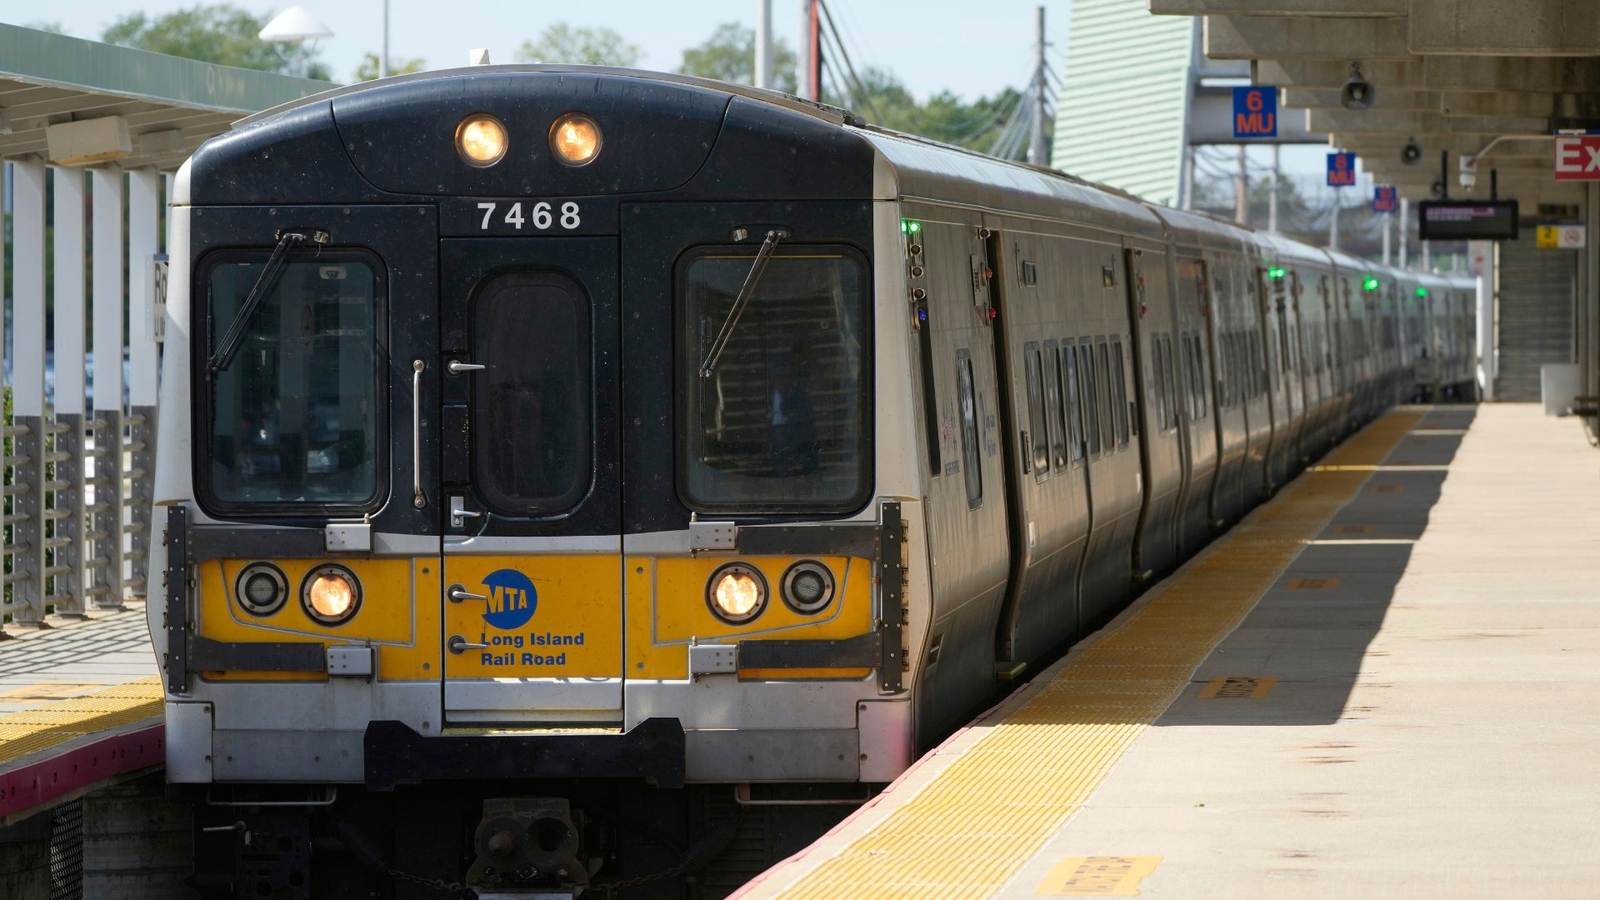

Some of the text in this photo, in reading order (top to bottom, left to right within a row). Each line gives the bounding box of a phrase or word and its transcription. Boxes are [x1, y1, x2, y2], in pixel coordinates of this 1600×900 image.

[1246, 90, 1263, 112] 6
[1236, 112, 1273, 134] MU
[1555, 137, 1600, 172] Ex
[1329, 169, 1355, 184] MU
[477, 201, 581, 230] 7468
[482, 584, 528, 614] MTA
[481, 632, 584, 648] Long Island
[481, 653, 566, 666] Rail Road
